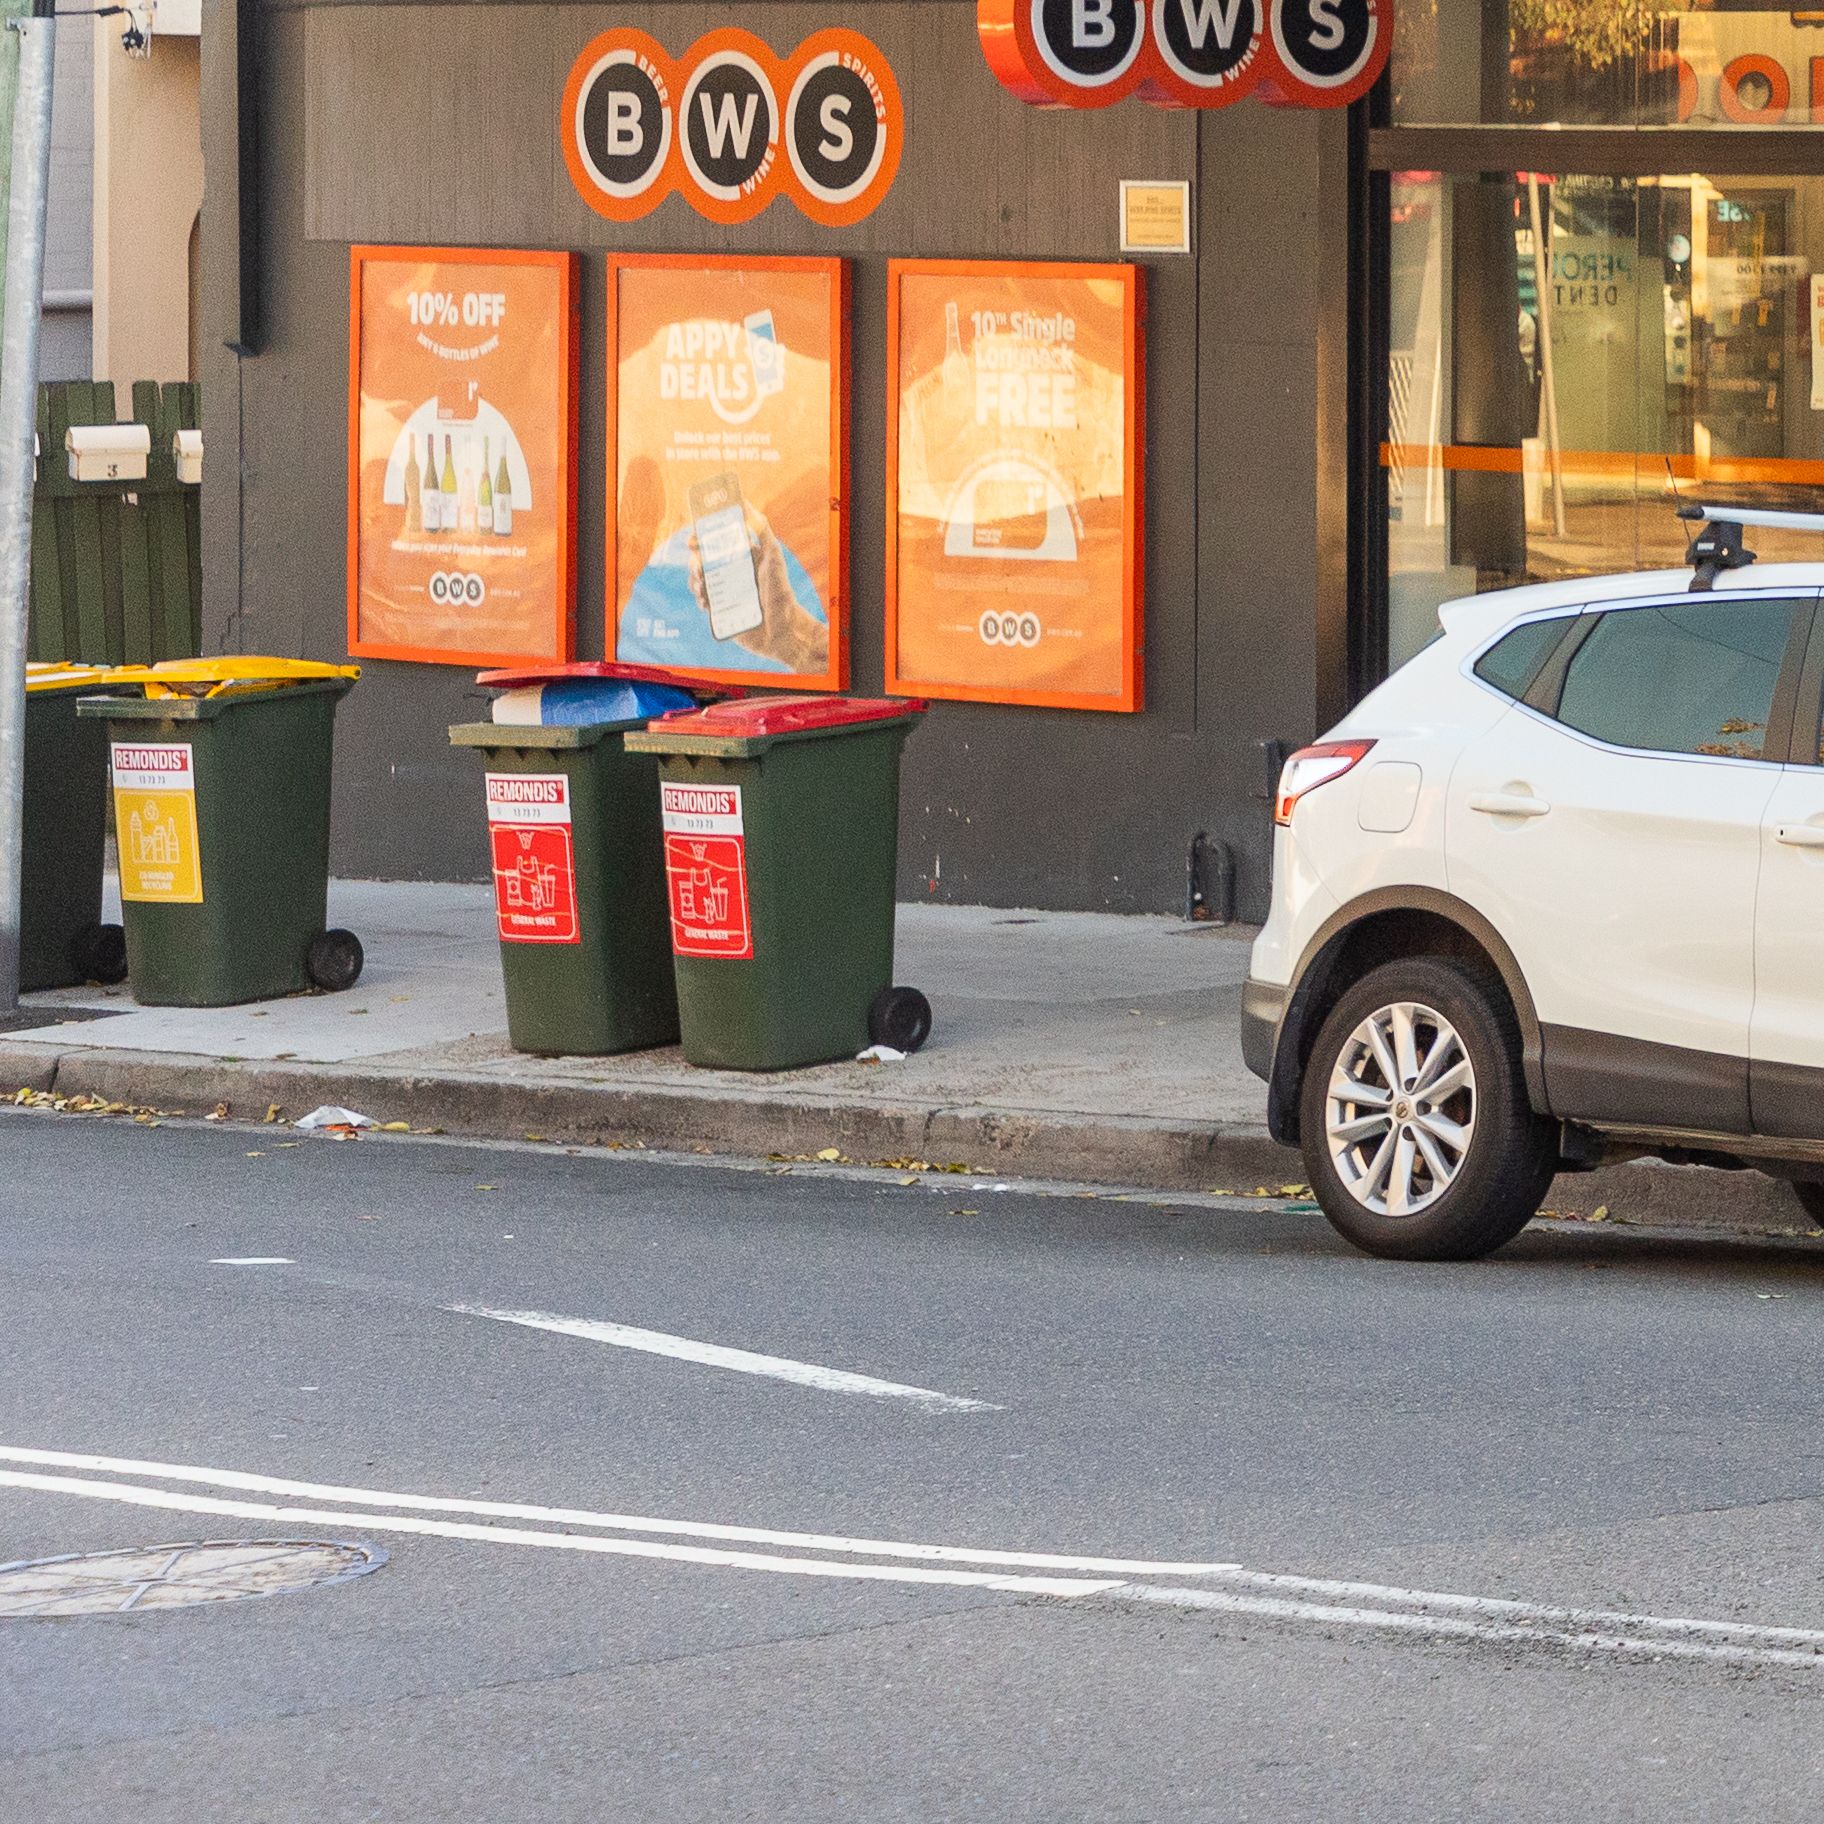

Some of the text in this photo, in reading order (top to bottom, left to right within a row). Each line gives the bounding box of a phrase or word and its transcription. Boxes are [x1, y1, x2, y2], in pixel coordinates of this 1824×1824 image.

[636, 53, 671, 103] BEER
[1223, 35, 1262, 84] WINE
[842, 52, 888, 120] SPIRITS
[741, 148, 777, 196] WINE
[407, 291, 506, 328] 10% OFF
[1011, 311, 1076, 343] Single
[665, 321, 743, 361] APPY
[975, 343, 1075, 371] Longneck
[660, 361, 750, 402] DEALS
[975, 373, 1078, 429] FREE
[108, 463, 119, 479] 3
[115, 747, 183, 773] REMONDIS
[489, 779, 558, 804] REMONDIS
[664, 789, 731, 815] REMONDIS
